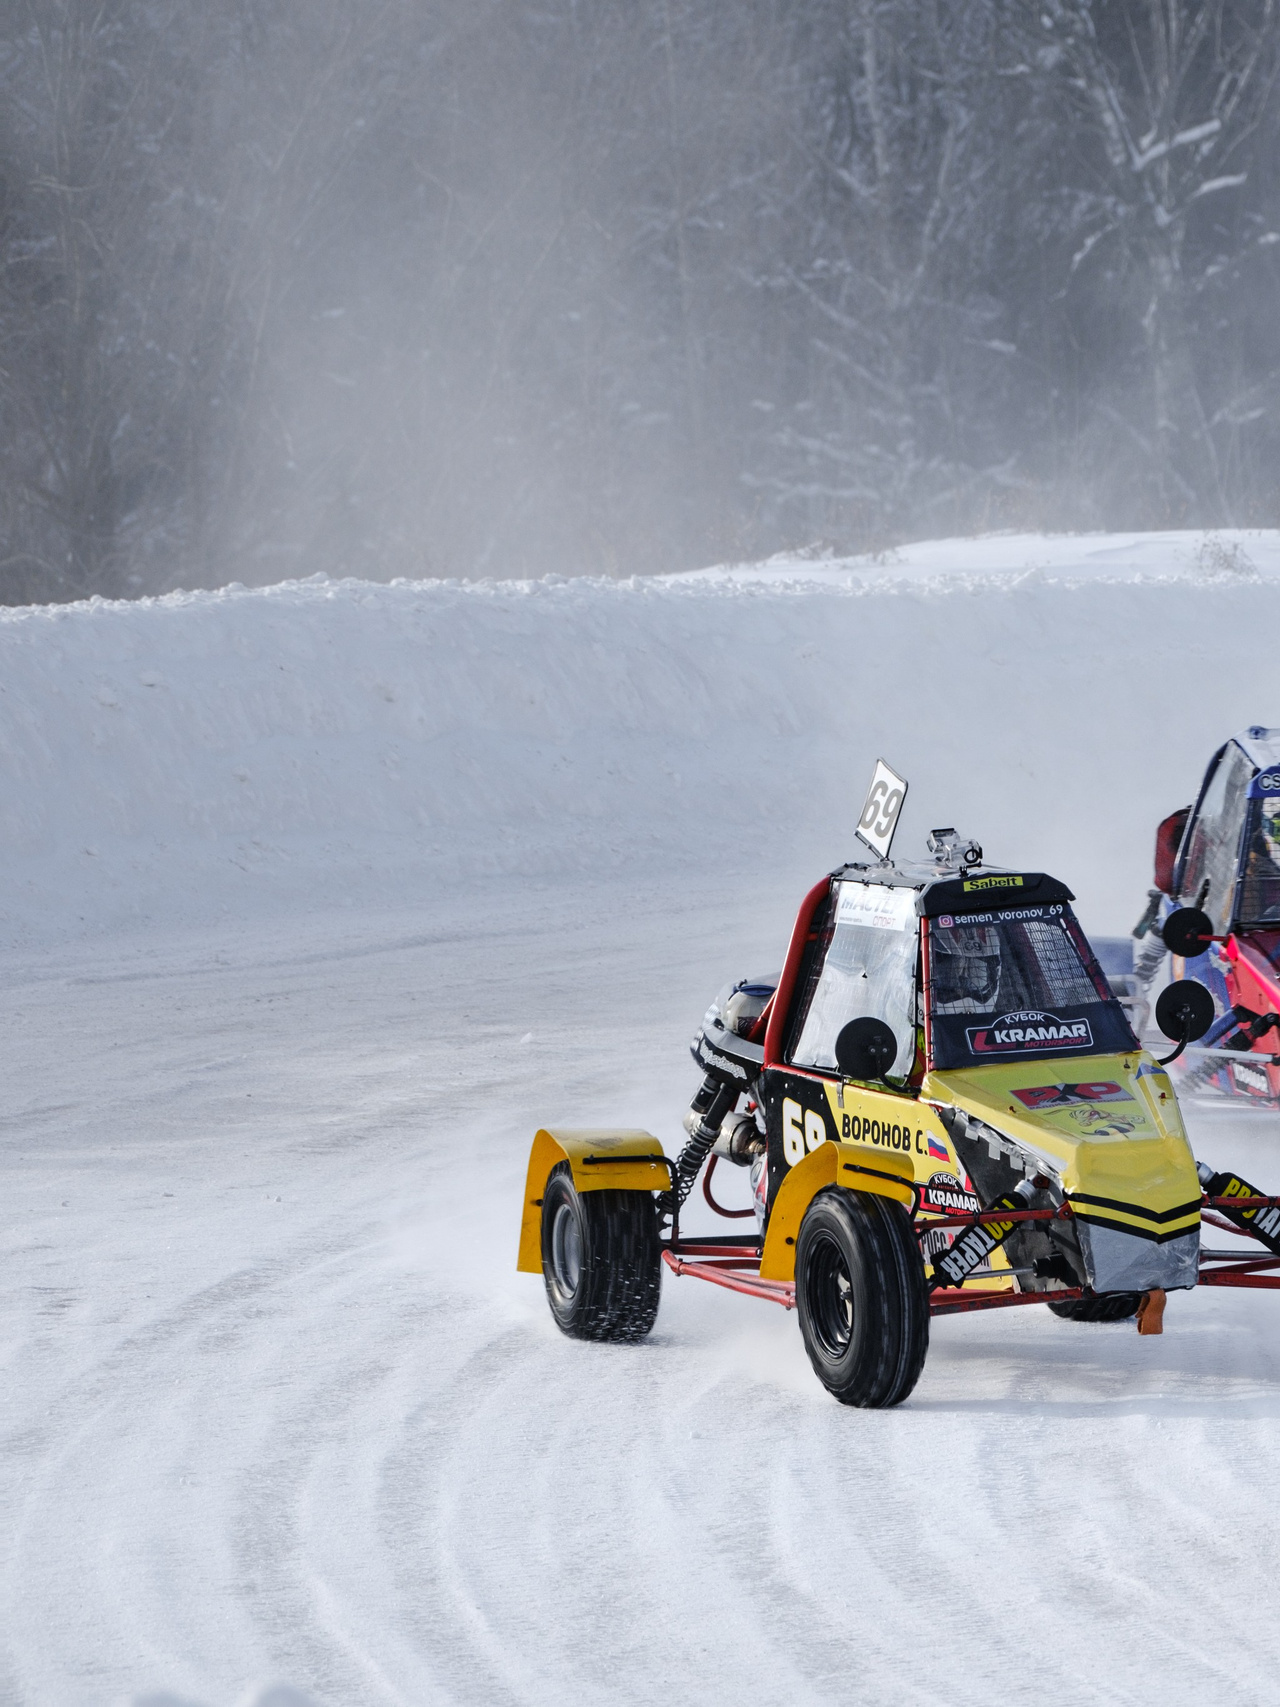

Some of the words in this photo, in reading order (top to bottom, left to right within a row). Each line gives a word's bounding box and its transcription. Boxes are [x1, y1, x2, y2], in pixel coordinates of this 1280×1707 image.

[860, 780, 904, 838] 69
[969, 877, 1017, 890] Sabelt
[955, 904, 1064, 924] semen_voronov_69
[1005, 1013, 1045, 1025] КУБОК
[994, 1023, 1088, 1044] KRAMAR
[1024, 1036, 1089, 1048] MOTORSPORT
[782, 1097, 827, 1167] 69
[842, 1113, 911, 1151] ВОРОНОВ
[915, 1129, 928, 1156] С.
[934, 1174, 959, 1189] КУБОК
[929, 1189, 979, 1213] KRAMAR
